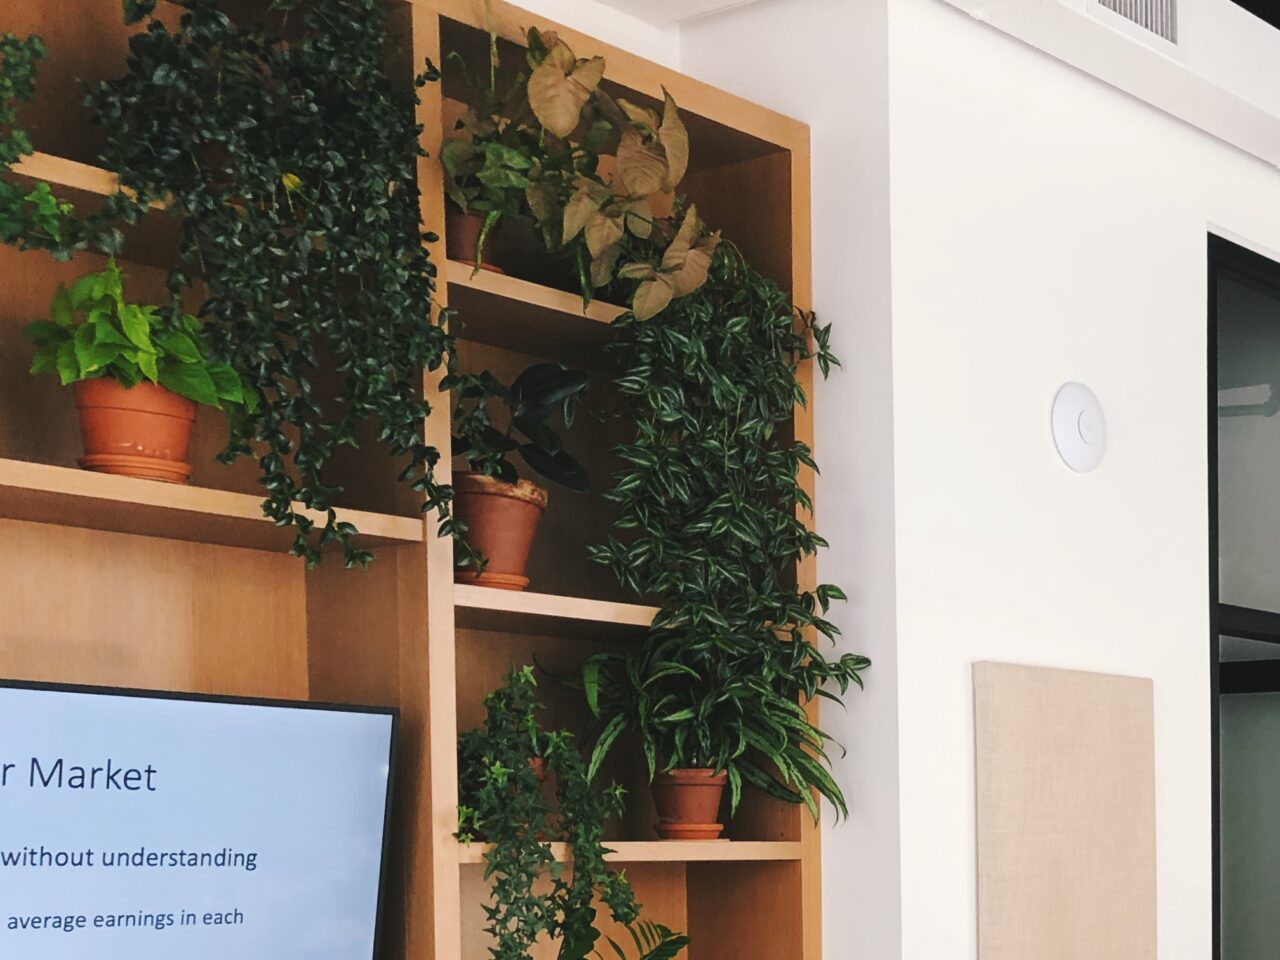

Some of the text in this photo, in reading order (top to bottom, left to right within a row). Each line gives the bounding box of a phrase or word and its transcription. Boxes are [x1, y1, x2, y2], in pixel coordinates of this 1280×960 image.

[2, 756, 158, 792] r Market
[0, 845, 259, 872] without understanding
[7, 908, 244, 933] average earnings in each
